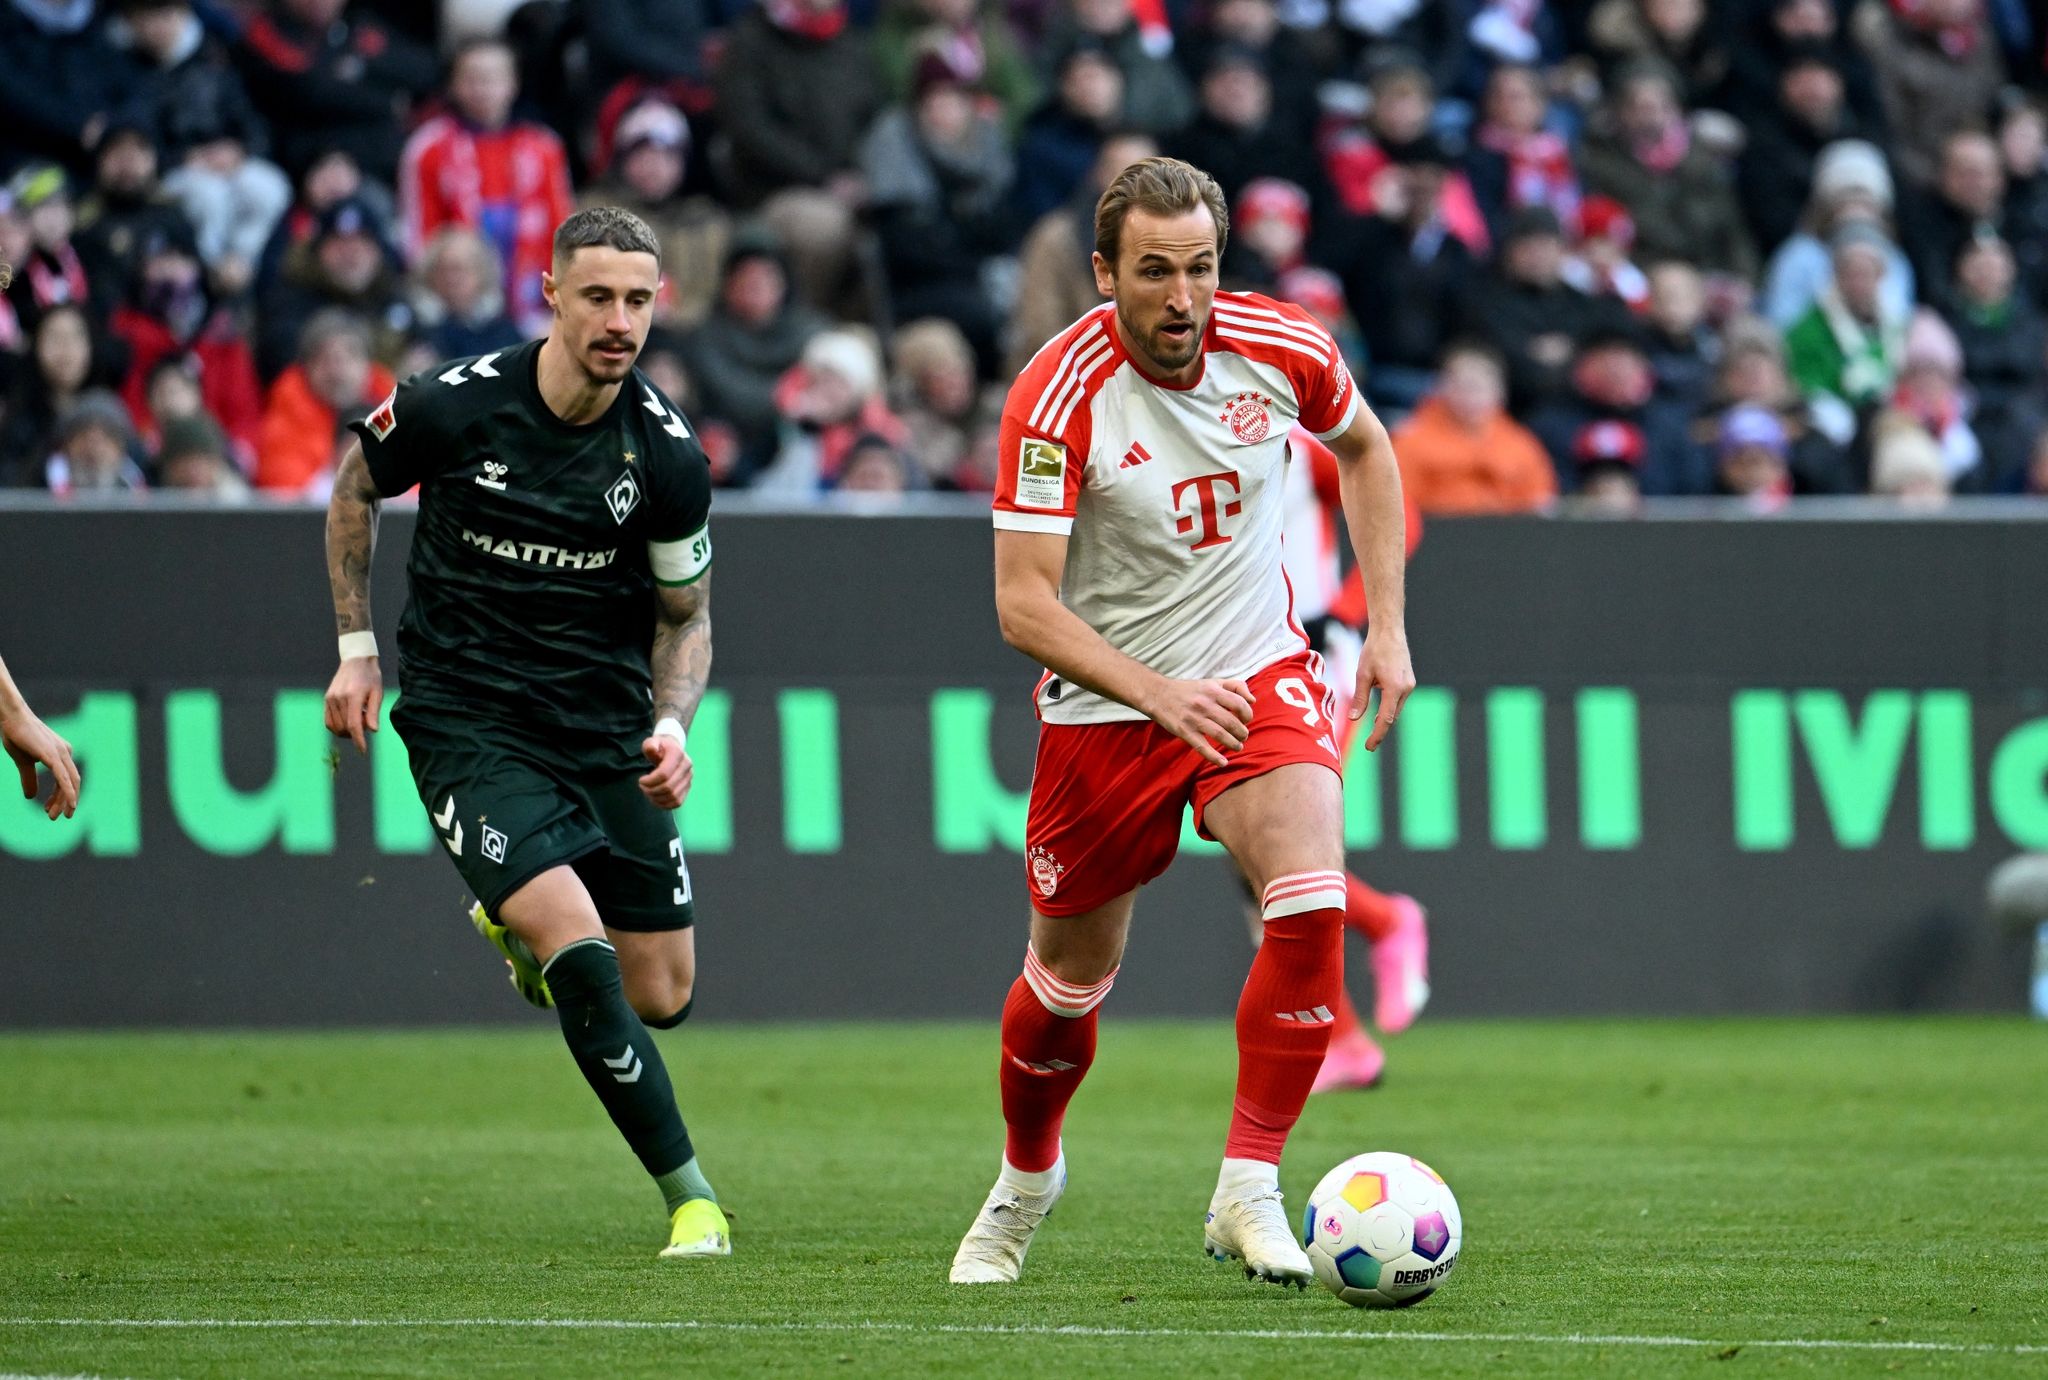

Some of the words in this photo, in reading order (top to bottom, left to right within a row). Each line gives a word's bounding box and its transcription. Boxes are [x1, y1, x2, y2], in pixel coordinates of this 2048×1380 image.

[1238, 405, 1264, 416] BAYERN
[1021, 476, 1060, 485] BUNDESLIGA
[1275, 678, 1320, 727] 9
[668, 836, 692, 906] 3
